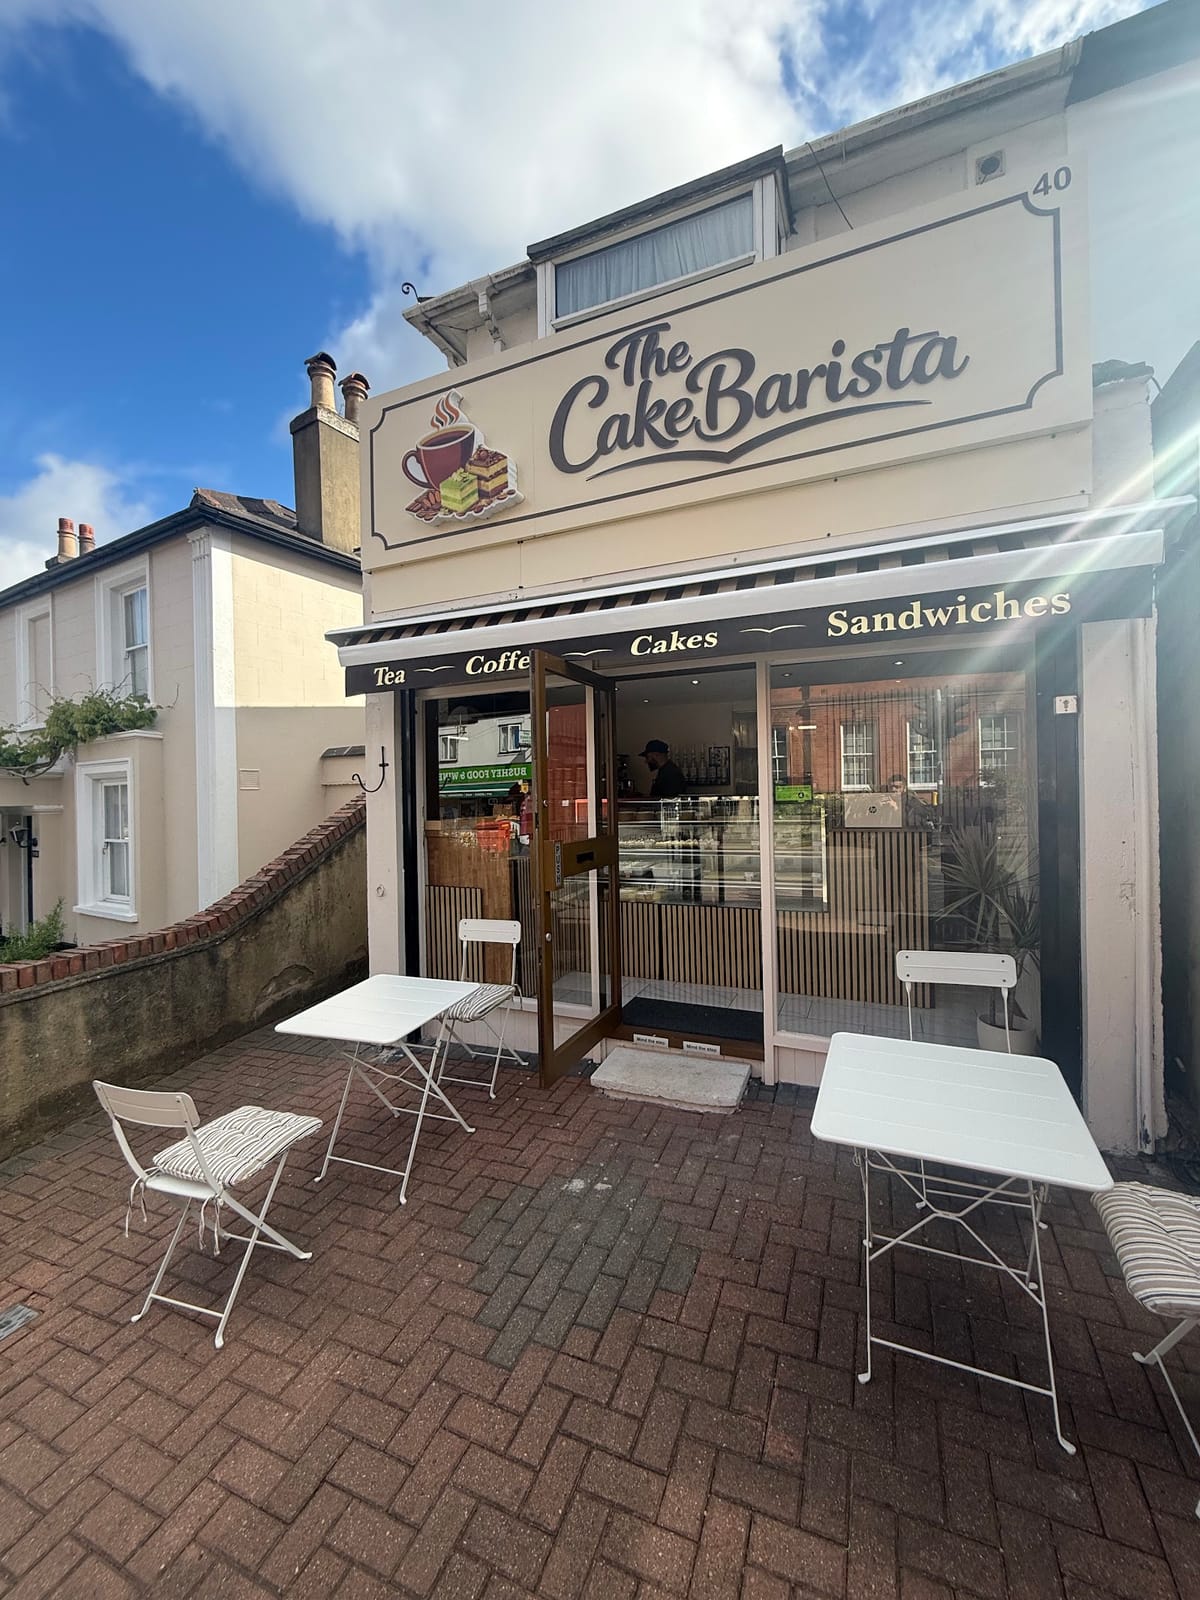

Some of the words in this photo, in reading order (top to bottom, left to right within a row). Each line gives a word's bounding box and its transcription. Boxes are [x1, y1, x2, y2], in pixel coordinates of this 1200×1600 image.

[1032, 166, 1072, 196] 40
[604, 322, 692, 386] The
[548, 375, 699, 474] Cake
[685, 327, 970, 442] Barista
[374, 666, 406, 687] Tea
[465, 650, 531, 675] Coffe
[630, 630, 718, 657] Cakes
[827, 590, 1072, 638] Sandwiches
